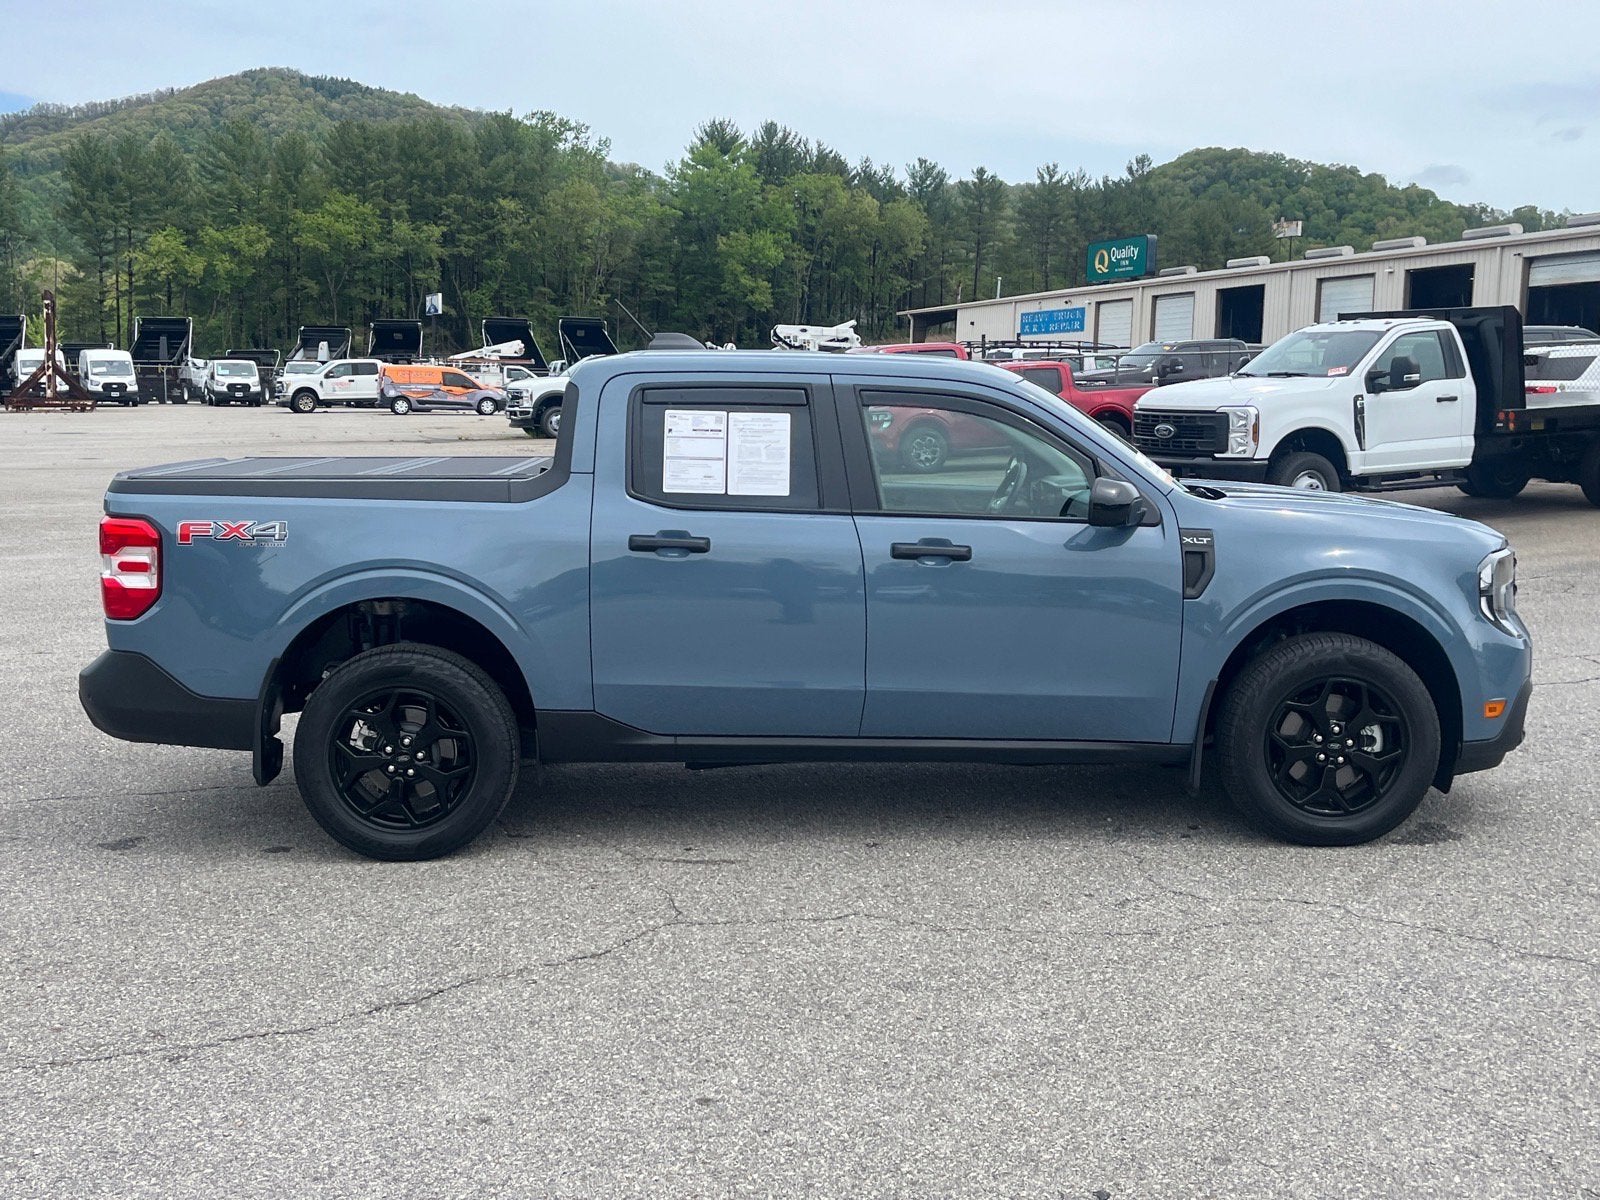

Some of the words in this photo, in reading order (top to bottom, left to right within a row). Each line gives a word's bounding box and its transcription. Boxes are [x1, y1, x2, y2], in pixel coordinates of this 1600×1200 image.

[1110, 245, 1139, 262] Quality
[1022, 313, 1049, 323] HEAVY
[1053, 310, 1082, 320] TRUCK
[1049, 321, 1081, 331] REPAIR
[177, 520, 288, 546] FX4
[1182, 536, 1211, 544] XLT
